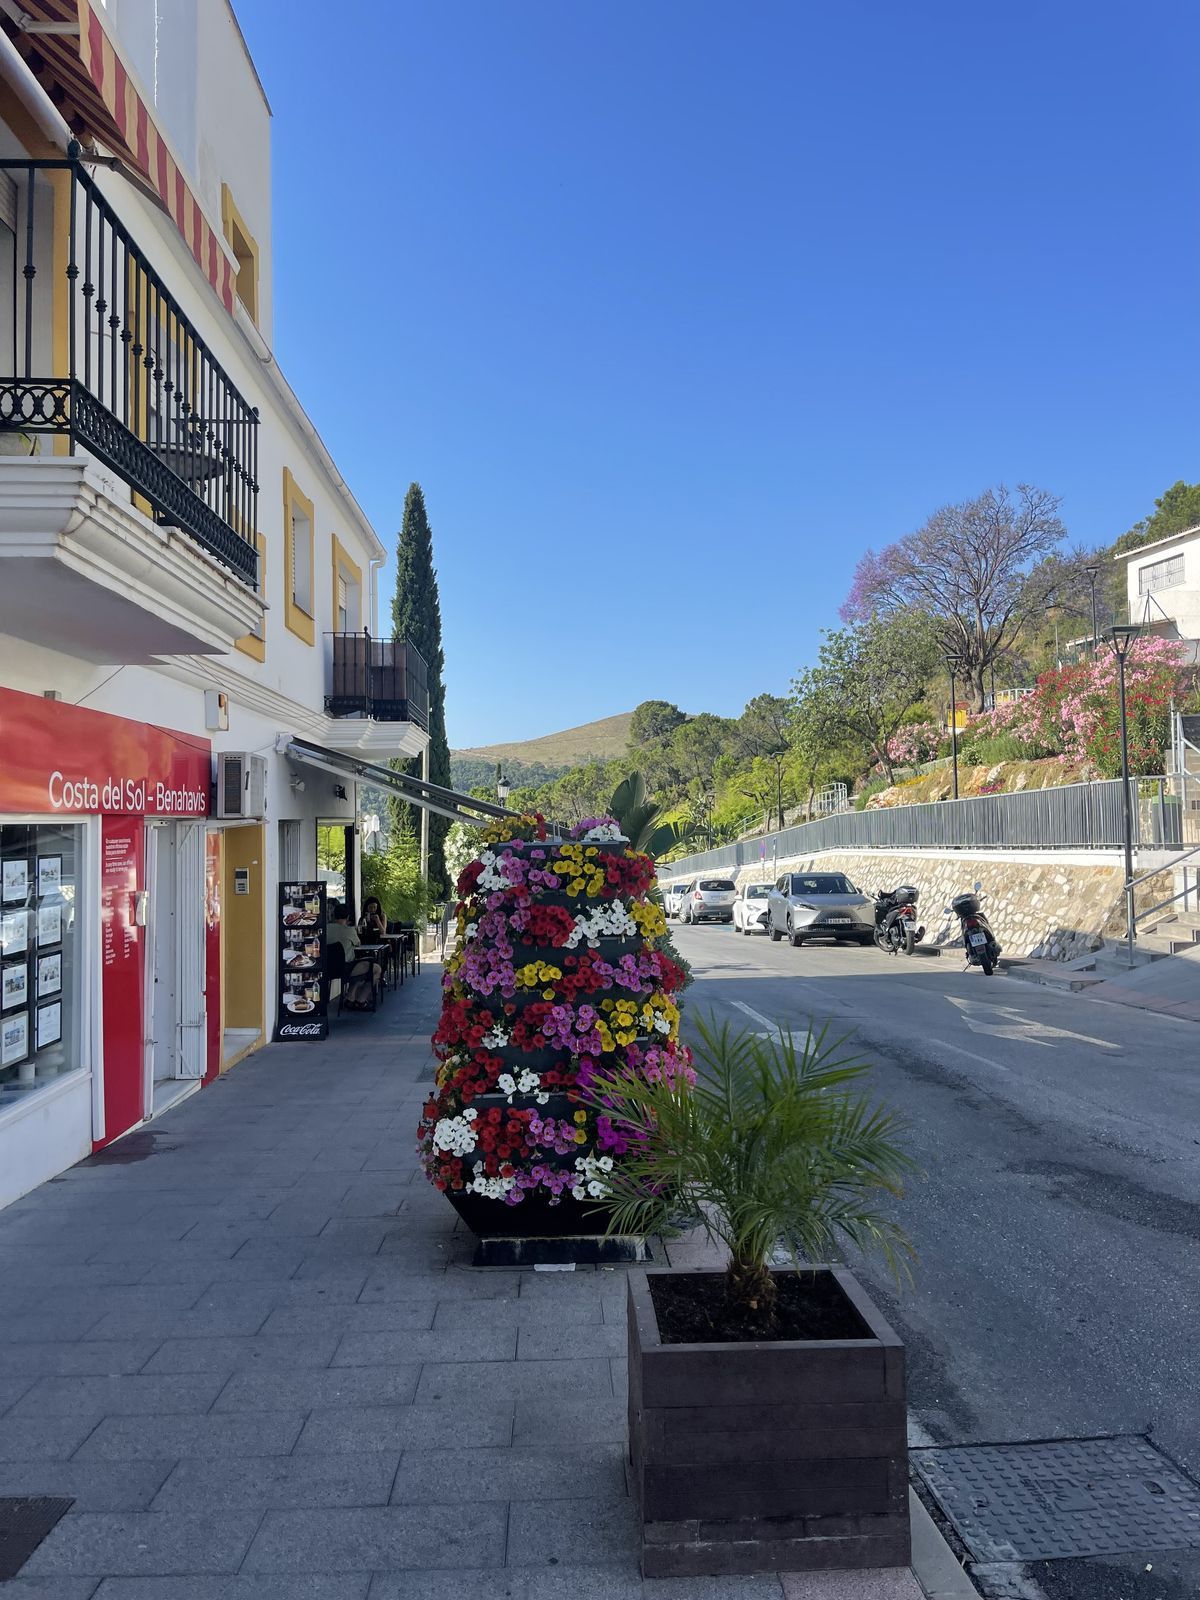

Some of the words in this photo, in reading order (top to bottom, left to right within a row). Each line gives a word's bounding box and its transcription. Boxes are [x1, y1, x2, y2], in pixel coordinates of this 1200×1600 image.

[49, 771, 98, 808] Costa
[102, 777, 123, 810] del
[126, 779, 145, 811] Sol
[156, 782, 206, 812] Benahavis
[280, 1023, 323, 1036] Coca-Cola
